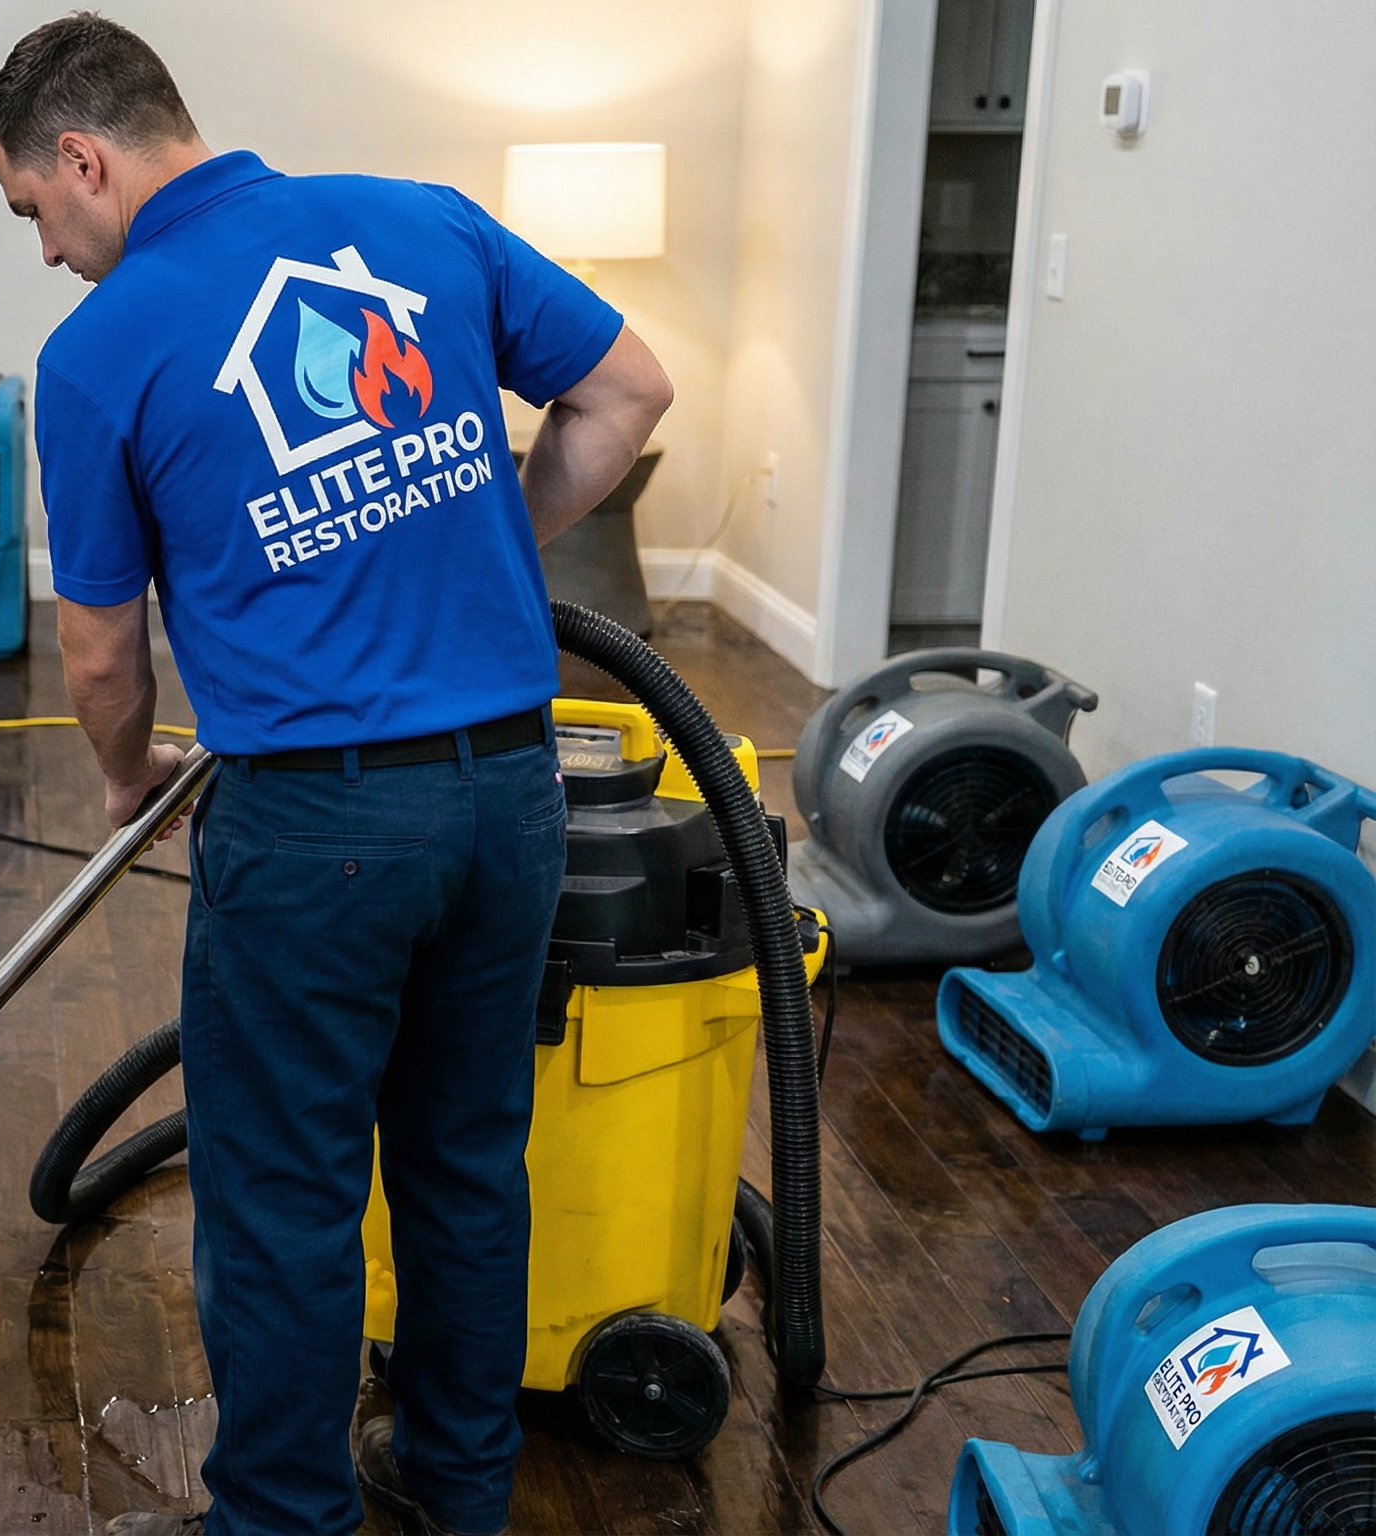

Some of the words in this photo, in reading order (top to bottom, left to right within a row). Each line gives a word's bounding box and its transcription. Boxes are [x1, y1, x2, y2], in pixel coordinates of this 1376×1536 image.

[246, 447, 392, 539] ELITE
[391, 411, 484, 478] PRO
[264, 452, 493, 573] RESTORATION
[1159, 1358, 1186, 1399] ELITE
[1179, 1393, 1202, 1426] PRO
